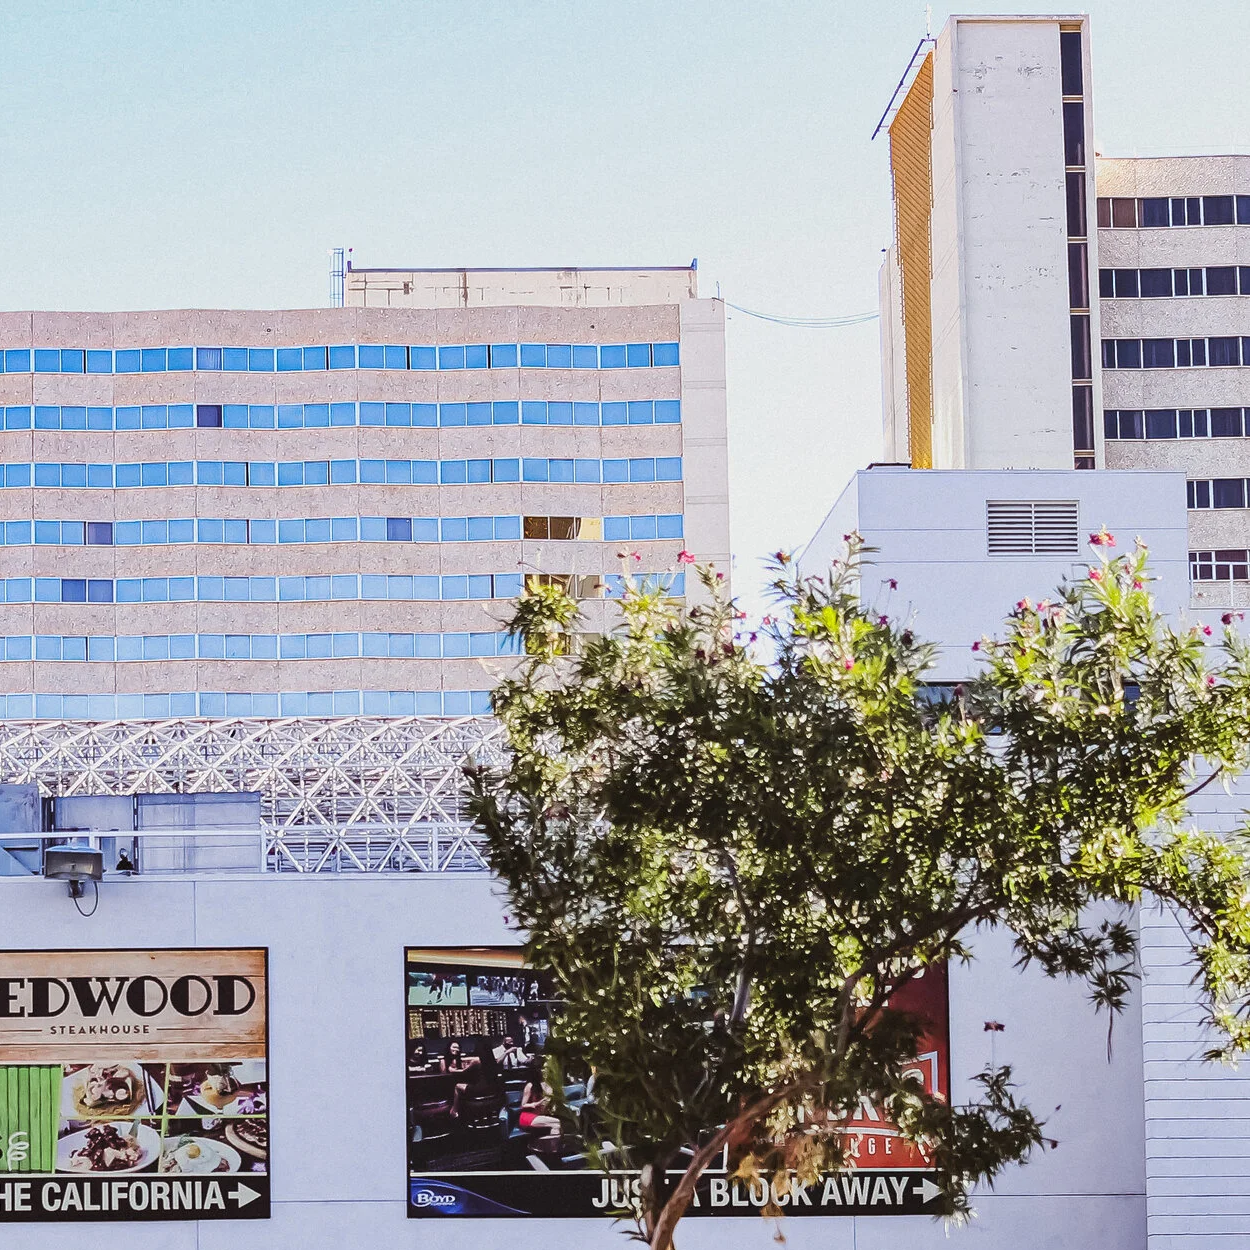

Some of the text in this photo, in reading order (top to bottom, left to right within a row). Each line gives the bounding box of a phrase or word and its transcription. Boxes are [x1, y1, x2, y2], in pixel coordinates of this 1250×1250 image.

[50, 1024, 150, 1035] STEAKHOUSE
[41, 1180, 226, 1211] CALIFORNIA
[591, 1178, 669, 1208] JUS
[710, 1177, 809, 1207] BLOCK
[821, 1176, 910, 1206] AWAY
